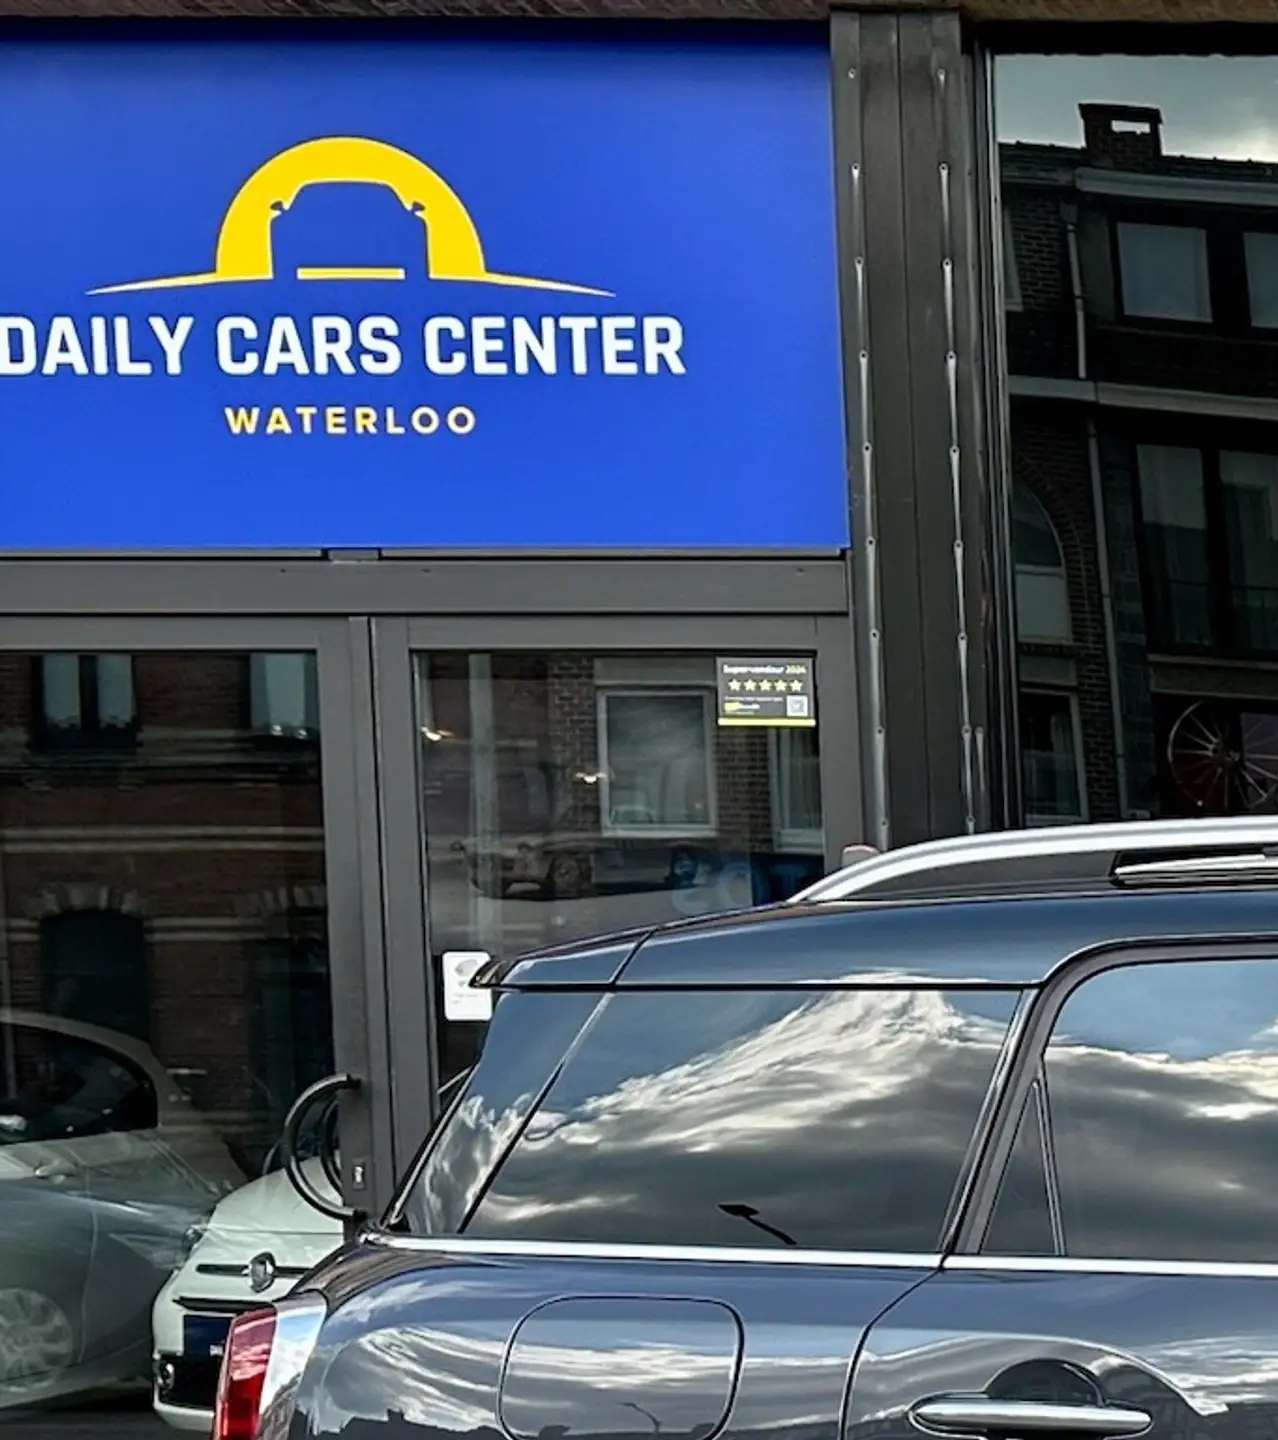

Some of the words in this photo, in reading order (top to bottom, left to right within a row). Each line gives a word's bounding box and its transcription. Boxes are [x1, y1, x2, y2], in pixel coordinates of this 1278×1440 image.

[0, 315, 194, 376] DAILY
[215, 315, 402, 376] CARS
[424, 315, 687, 376] CENTER
[225, 406, 477, 435] WATERLOO
